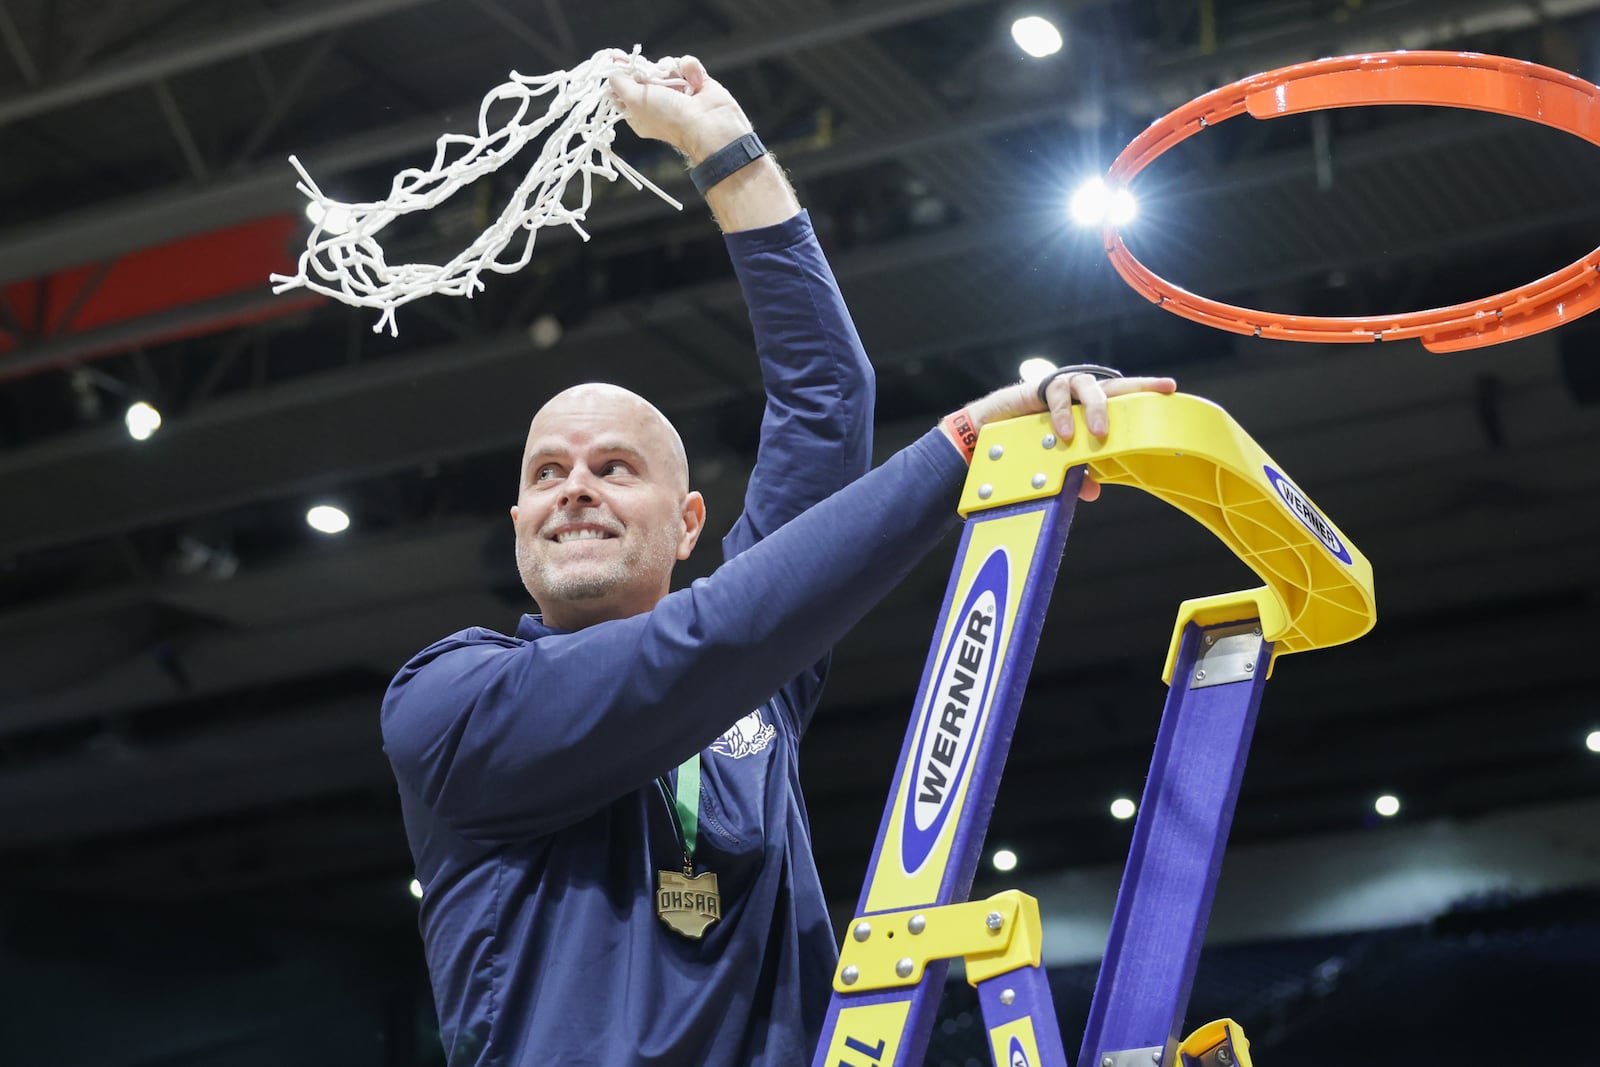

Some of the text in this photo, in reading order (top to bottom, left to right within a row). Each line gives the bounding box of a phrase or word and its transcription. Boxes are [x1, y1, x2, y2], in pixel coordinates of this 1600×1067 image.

[1282, 482, 1336, 548] WERNER
[918, 609, 993, 804] WERNER
[661, 891, 717, 914] OHSAA
